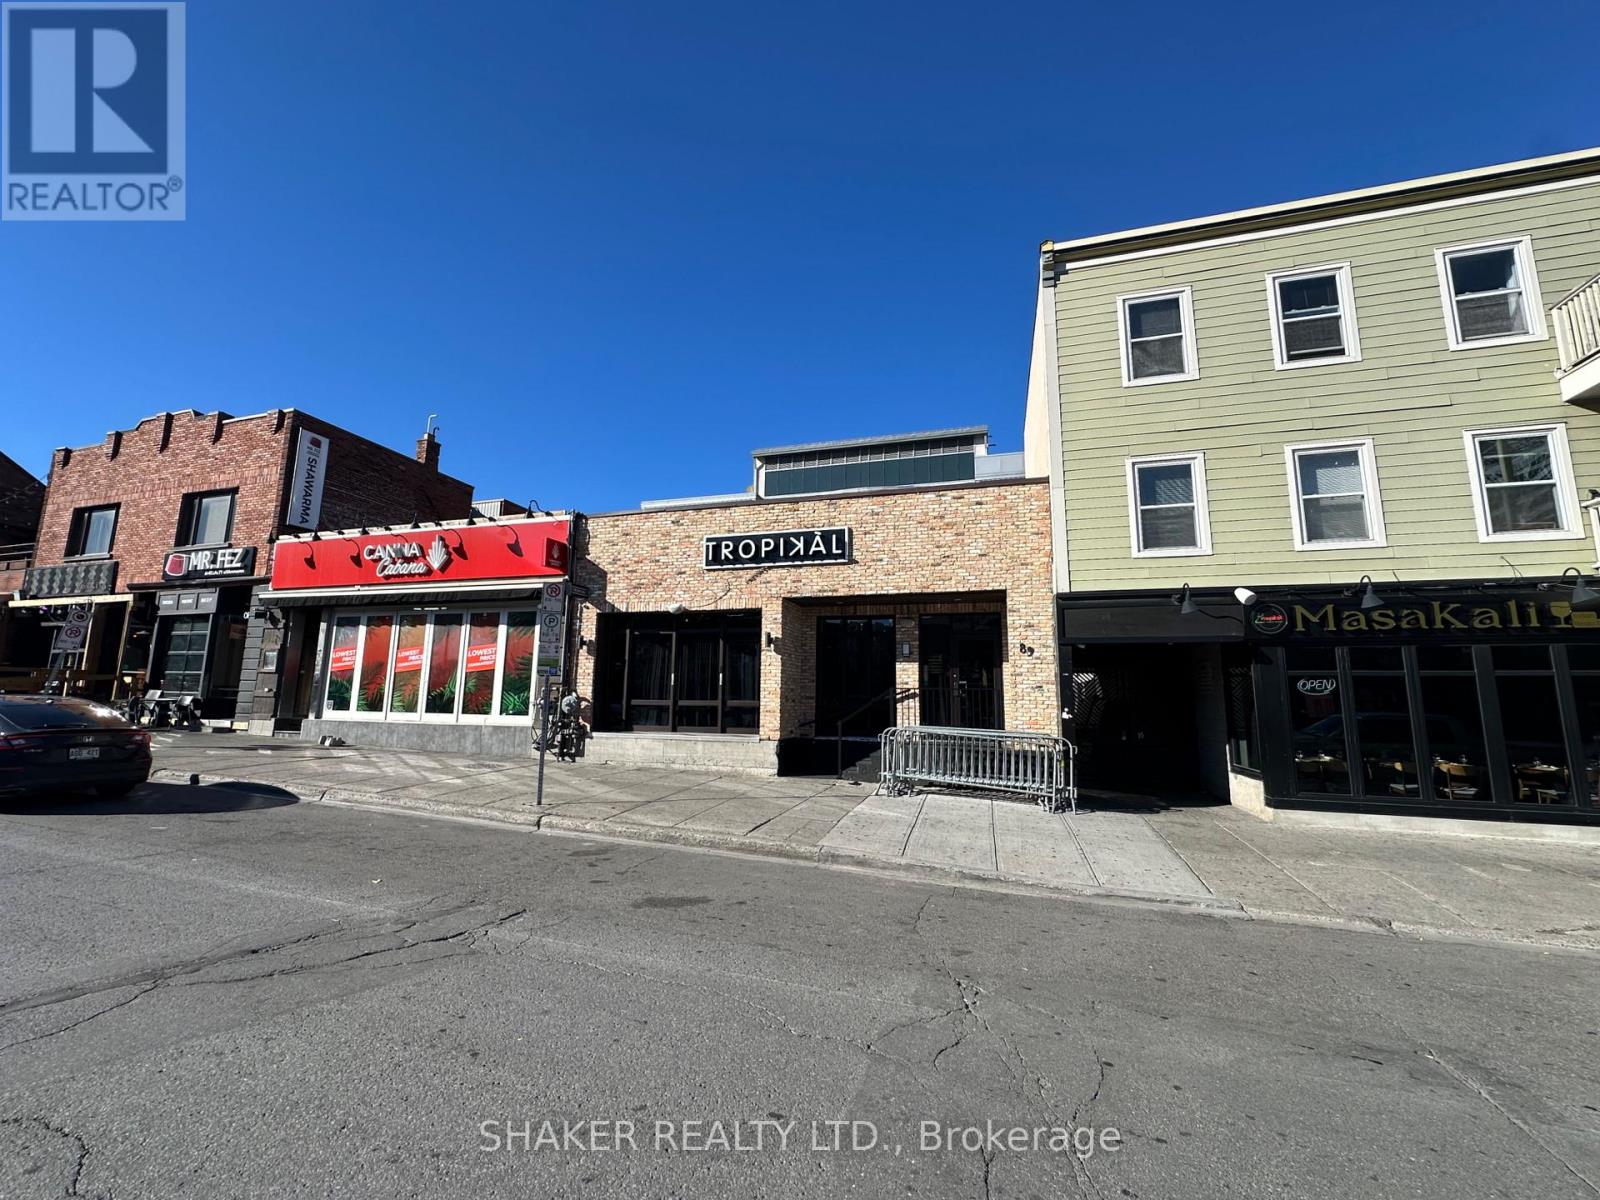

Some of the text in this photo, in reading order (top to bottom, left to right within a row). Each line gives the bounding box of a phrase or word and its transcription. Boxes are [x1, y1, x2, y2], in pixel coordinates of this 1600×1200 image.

[299, 457, 318, 525] SHAWARMA
[216, 547, 243, 570] FEZ
[376, 557, 426, 577] Cabana
[333, 650, 356, 658] LOWEST
[468, 648, 496, 657] LOWEST
[1020, 643, 1034, 657] 89
[1299, 679, 1332, 691] OPEN
